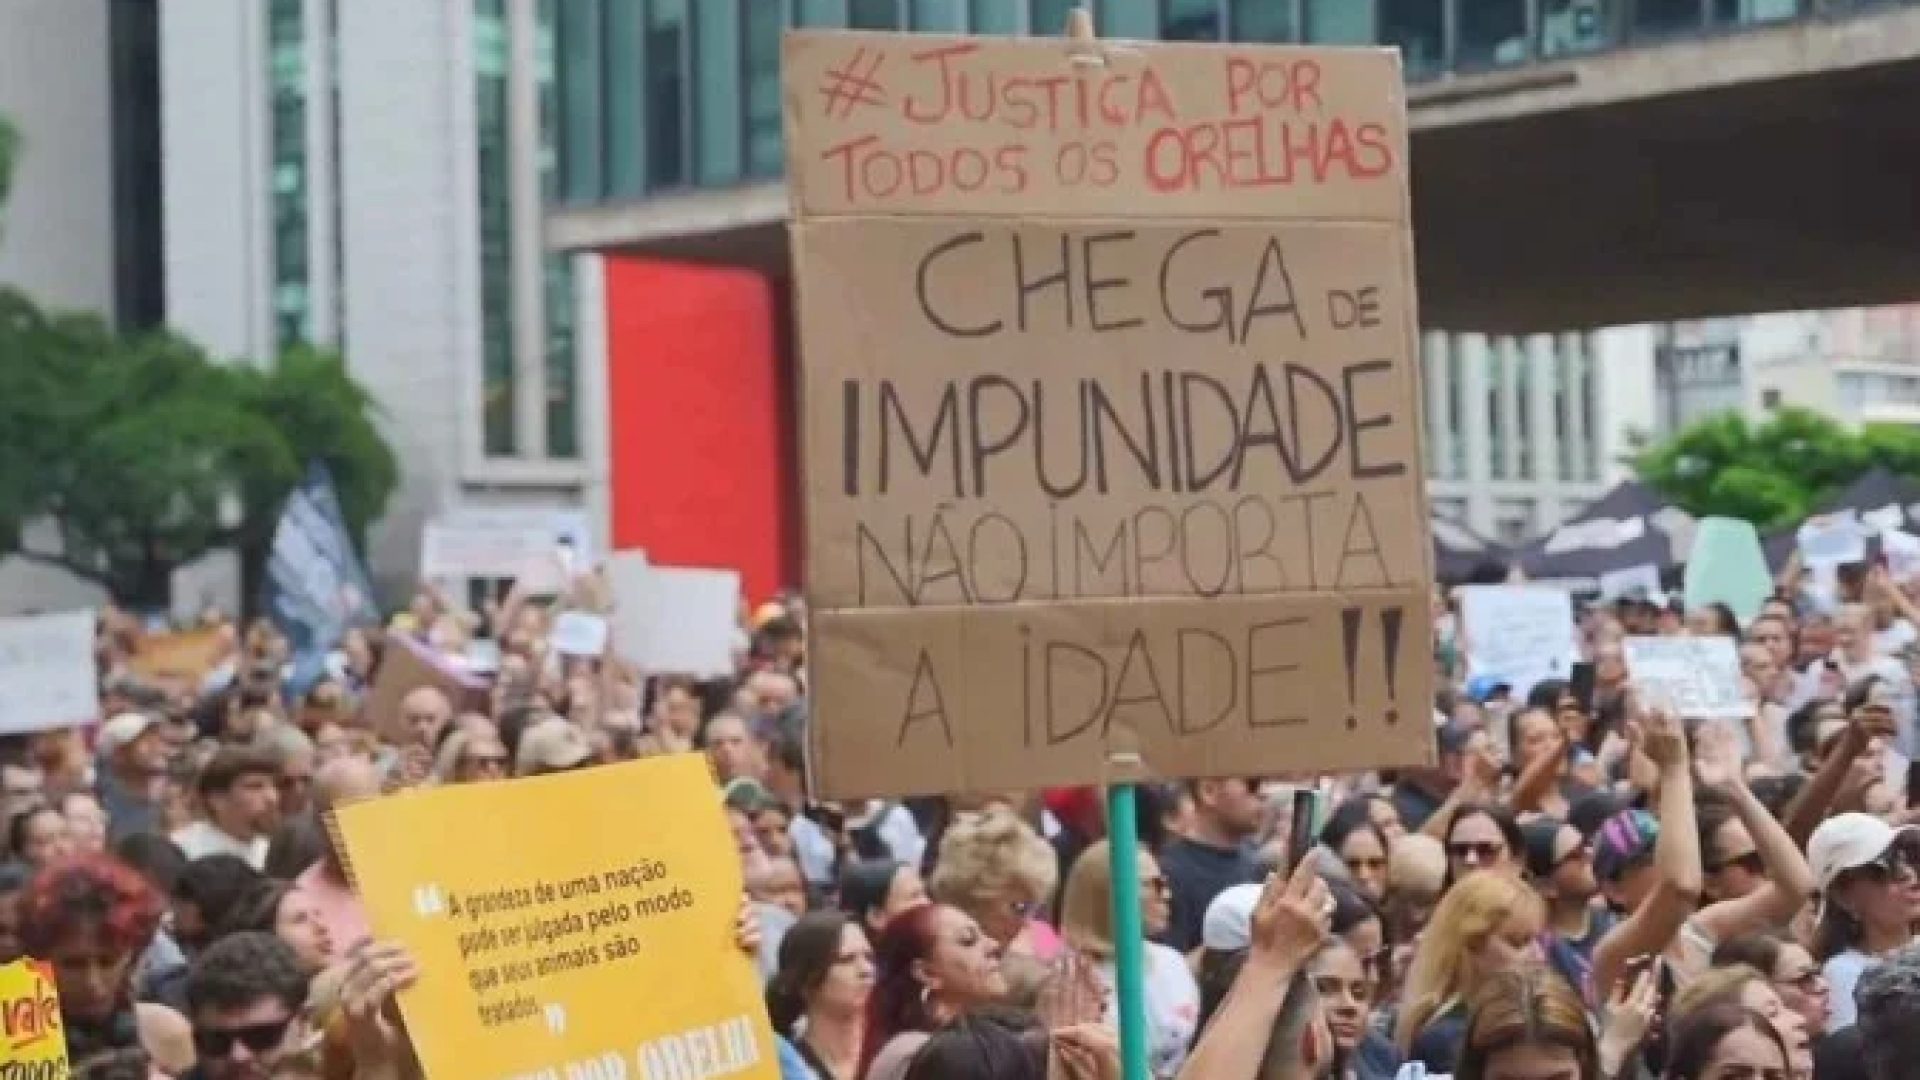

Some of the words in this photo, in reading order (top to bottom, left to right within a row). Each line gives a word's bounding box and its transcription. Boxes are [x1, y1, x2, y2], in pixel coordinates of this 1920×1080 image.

[1226, 57, 1322, 116] POR
[821, 134, 1027, 202] TODOS
[1055, 141, 1120, 188] OS
[1144, 114, 1393, 192] ORELHAS
[915, 228, 1306, 345] CHEGA
[1328, 286, 1381, 331] DE
[842, 359, 1407, 498] IMPUNIDADE
[856, 501, 1028, 606] NÃO
[898, 647, 953, 748] A
[534, 878, 556, 904] de
[559, 873, 601, 900] uma
[603, 858, 667, 889] nação
[586, 900, 630, 935] pelo
[636, 885, 694, 918] modo
[468, 965, 499, 994] que
[535, 940, 601, 977] animais
[602, 932, 641, 962] são
